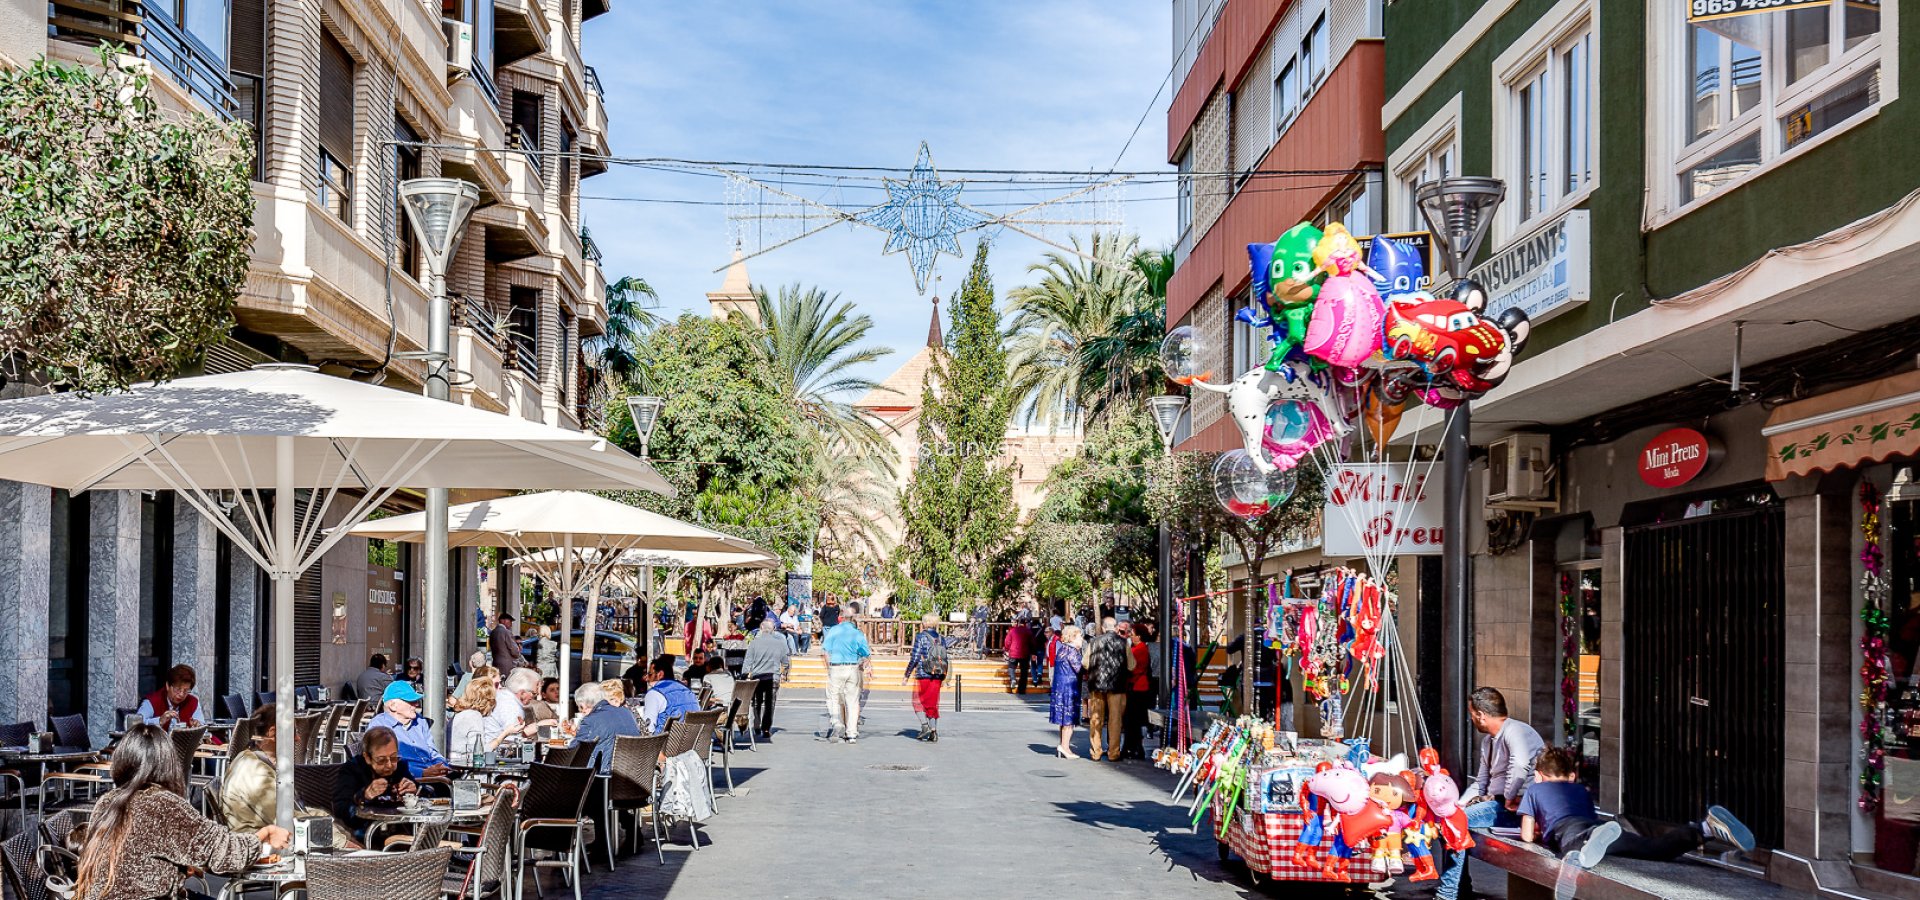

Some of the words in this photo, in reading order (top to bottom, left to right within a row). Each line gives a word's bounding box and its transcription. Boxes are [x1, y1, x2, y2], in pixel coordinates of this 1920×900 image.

[1693, 0, 1737, 16] 965
[1645, 444, 1669, 470] Mini
[1670, 442, 1700, 464] Preus
[1664, 466, 1680, 480] Moda
[1331, 470, 1427, 507] Mini
[1362, 510, 1444, 548] Preu
